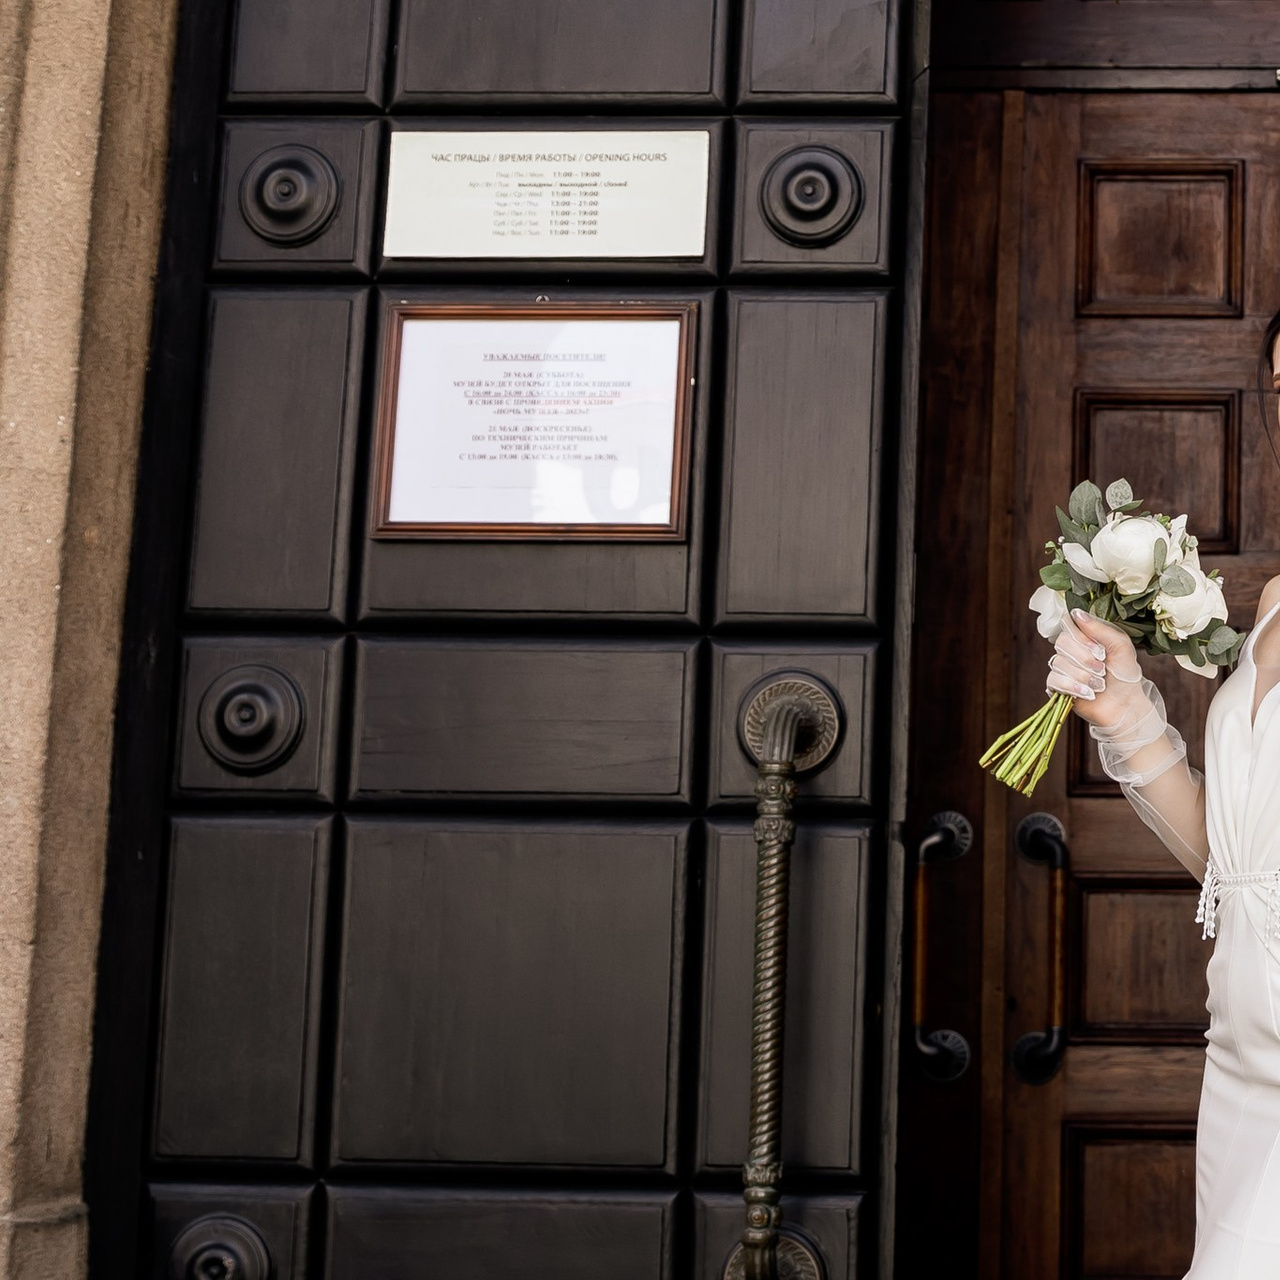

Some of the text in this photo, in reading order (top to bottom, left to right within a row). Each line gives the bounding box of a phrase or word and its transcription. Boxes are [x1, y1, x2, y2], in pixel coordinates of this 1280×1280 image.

[431, 153, 452, 162] ЧАС
[454, 153, 490, 163] ПРАЦЫ
[498, 153, 533, 162] ВРЕМЯ
[535, 153, 576, 162] РАБОТЫ
[585, 152, 630, 162] OPENING
[632, 152, 667, 162] HOURS
